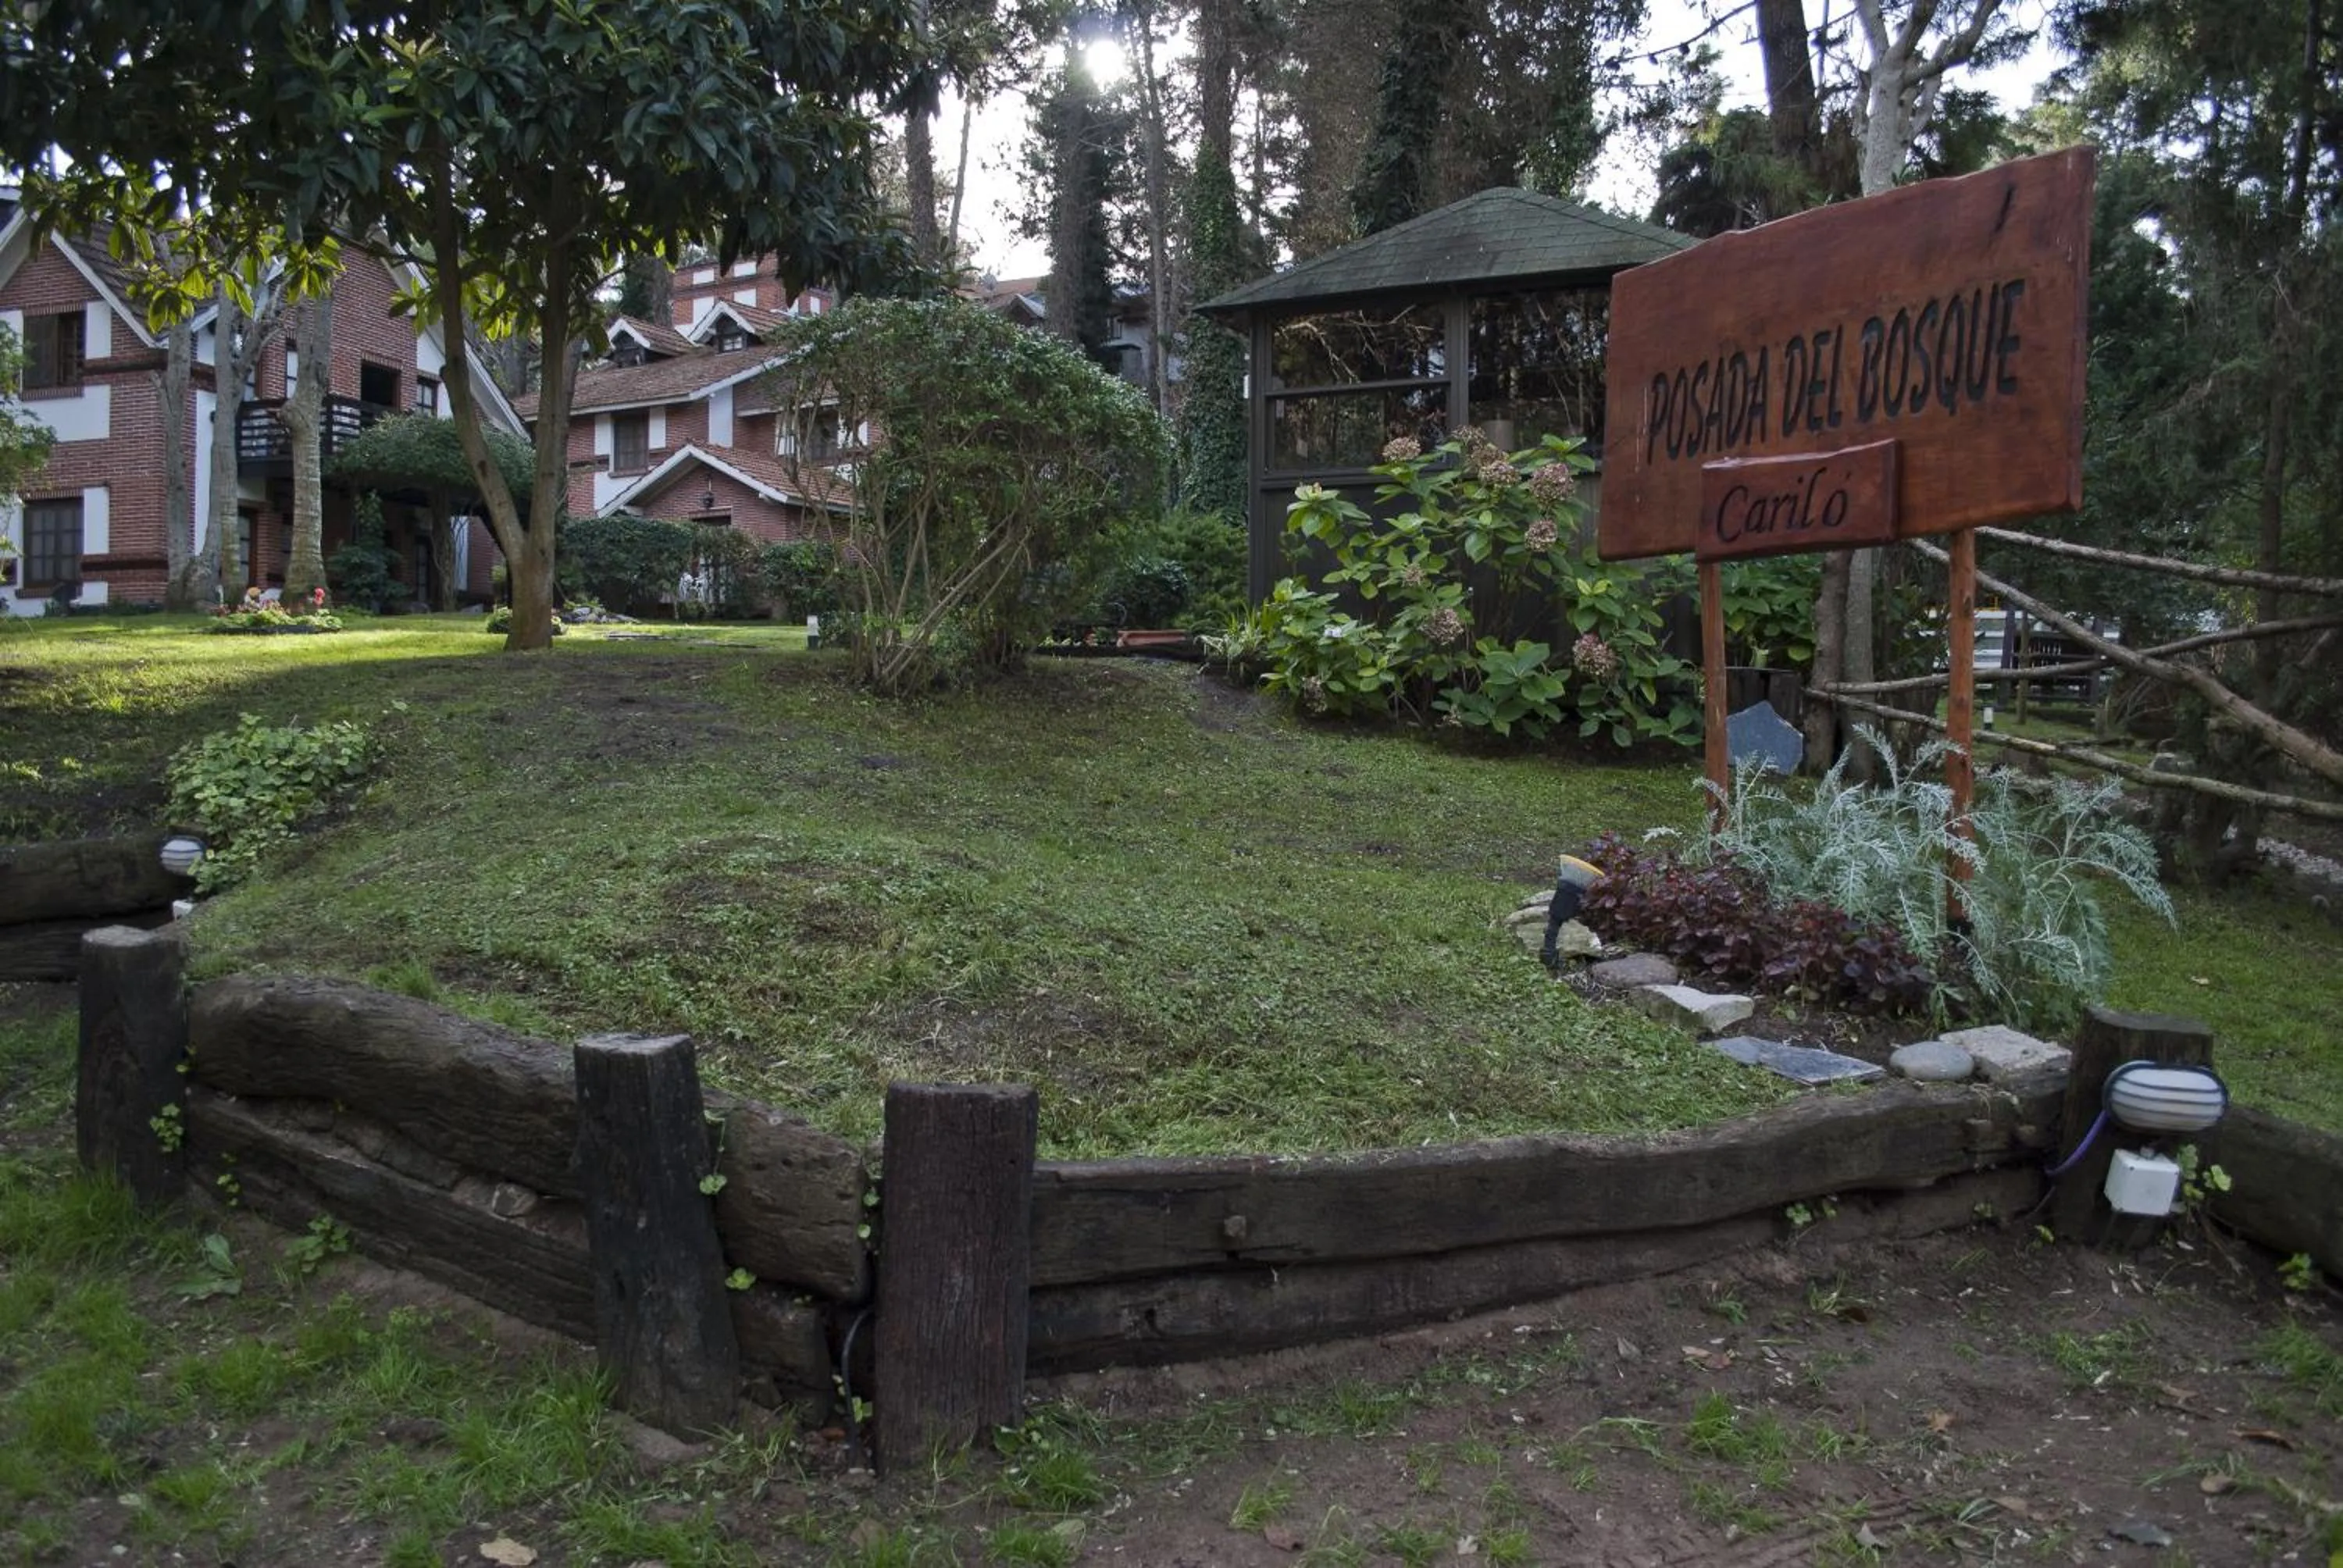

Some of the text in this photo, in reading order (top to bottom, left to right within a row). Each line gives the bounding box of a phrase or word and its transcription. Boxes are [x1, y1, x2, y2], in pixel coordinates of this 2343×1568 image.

[1647, 280, 2025, 465] POSADA DEL BOSQUE
[1717, 467, 1850, 543] Cariló
